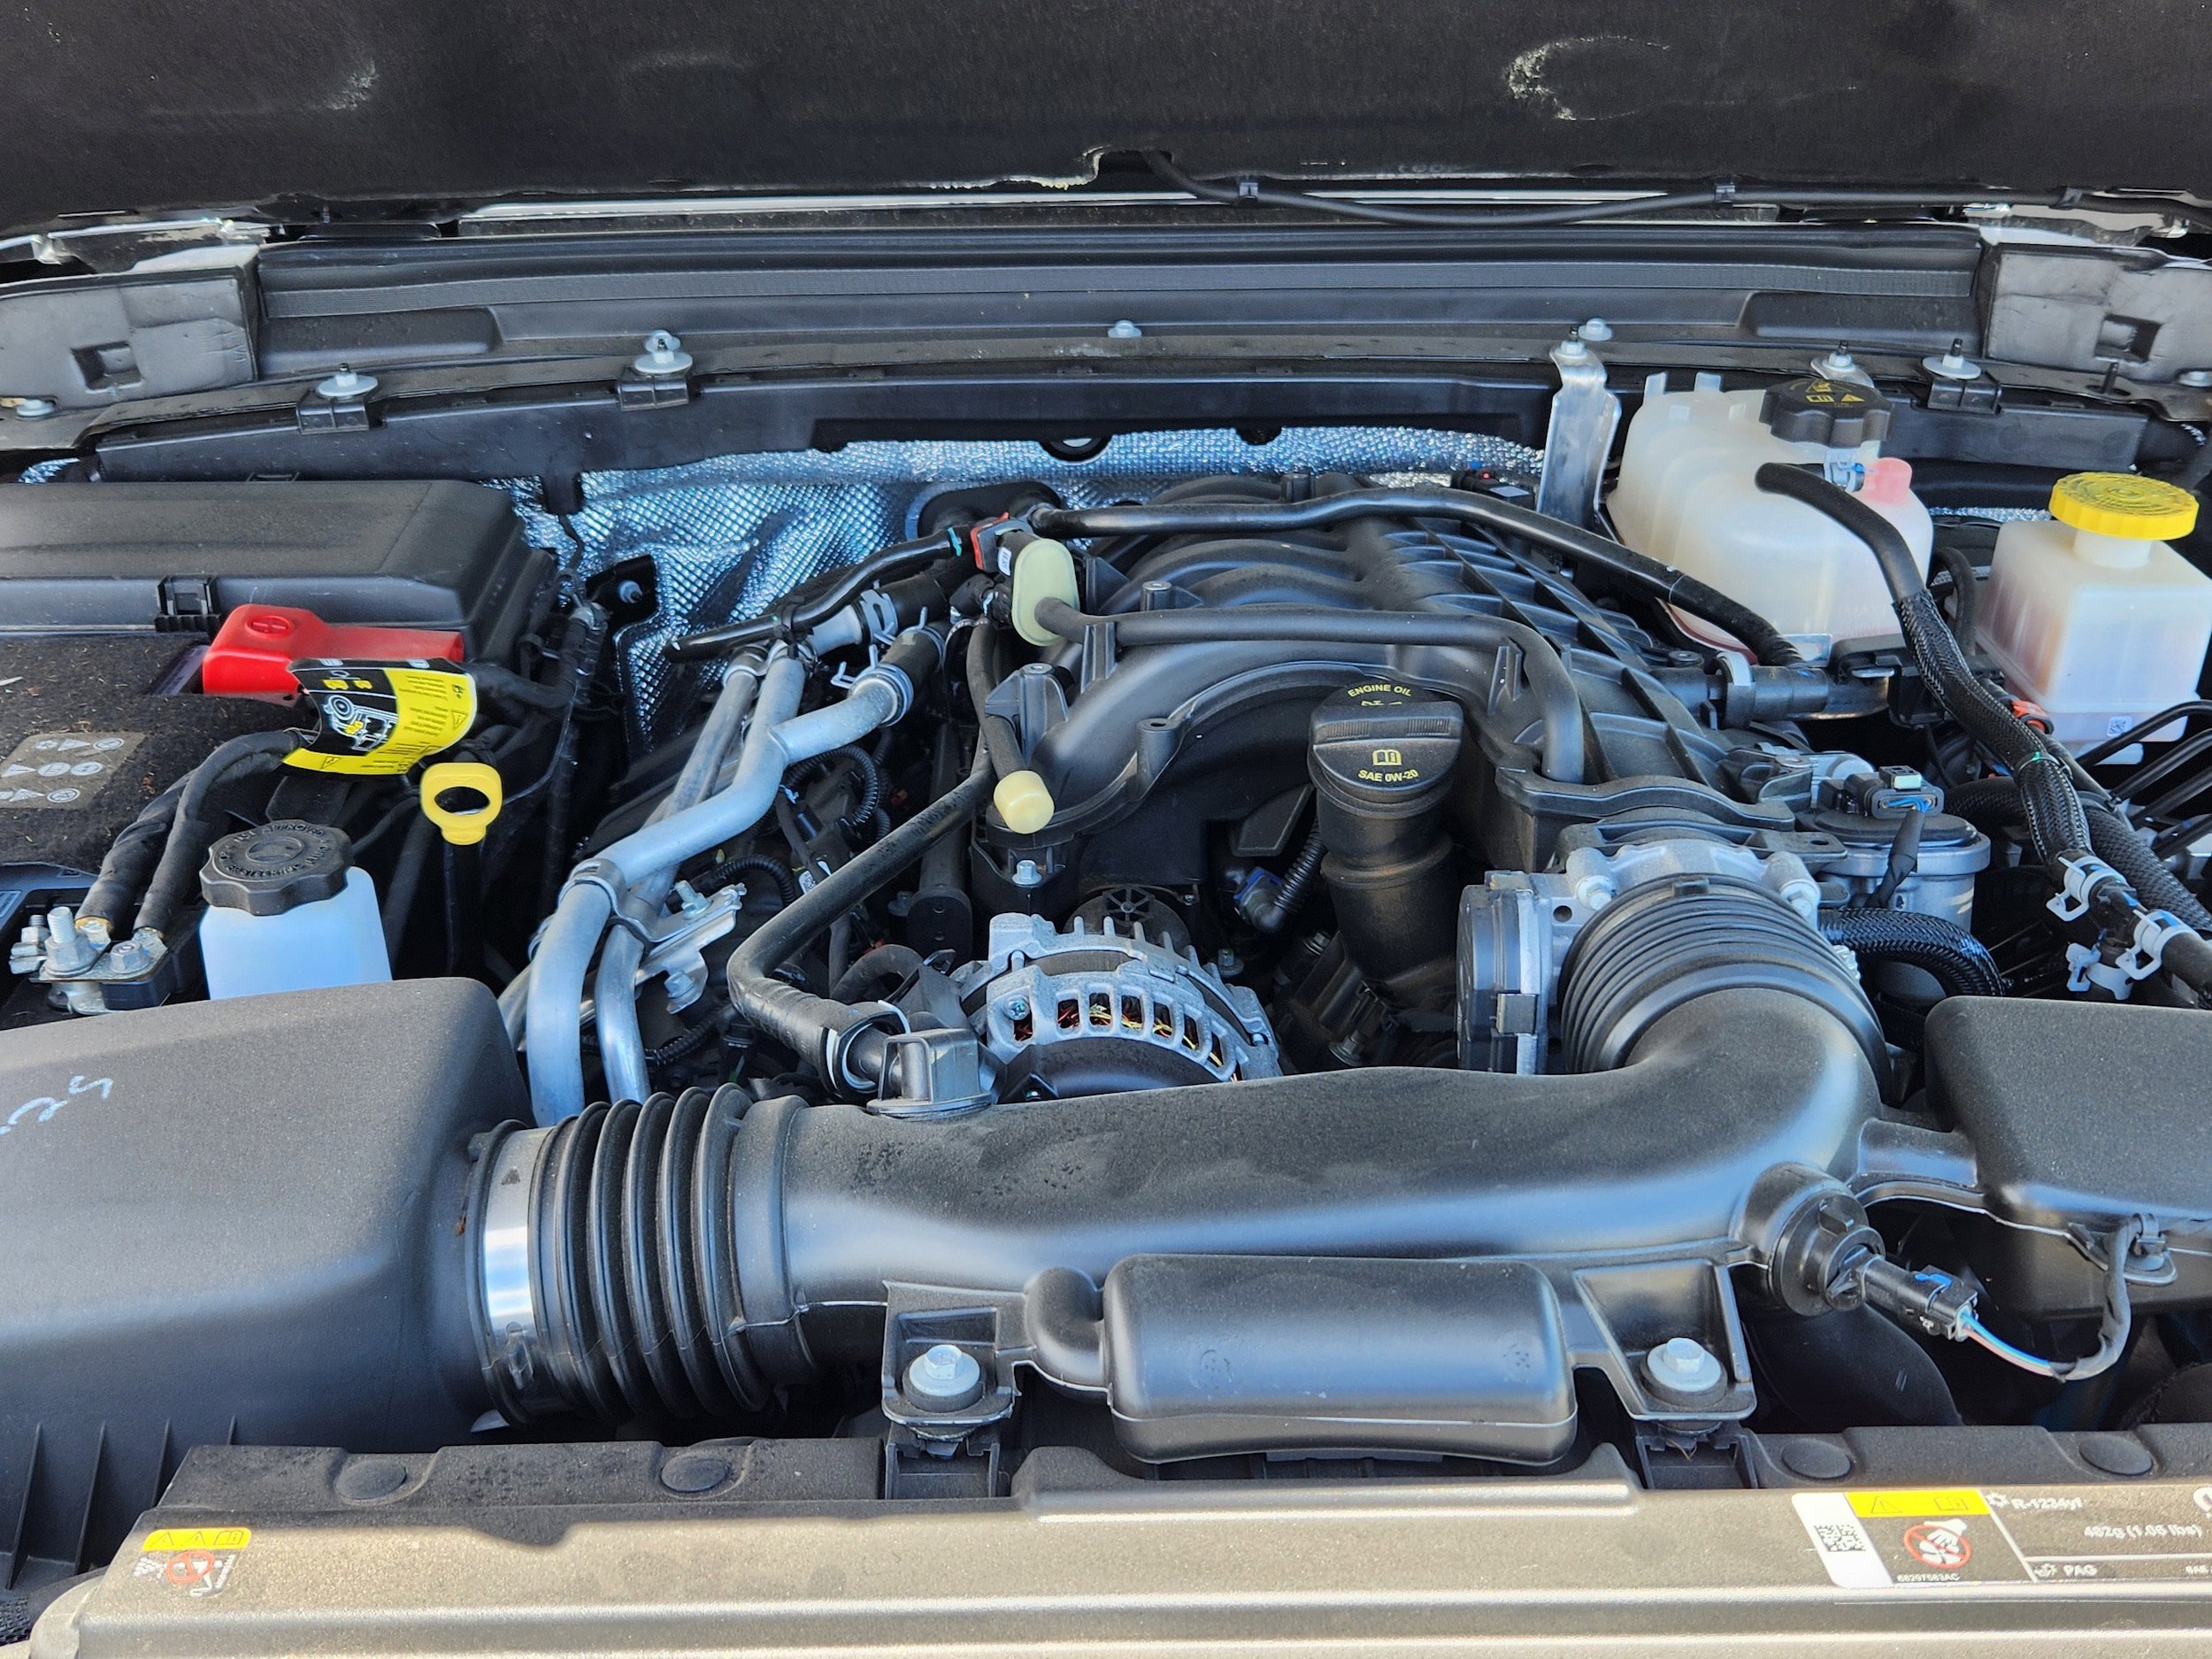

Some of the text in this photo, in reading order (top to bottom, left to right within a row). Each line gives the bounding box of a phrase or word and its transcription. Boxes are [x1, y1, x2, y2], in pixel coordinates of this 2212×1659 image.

[1347, 684, 1413, 697] ENGINE OIL
[1357, 769, 1418, 782] SAE 0W-20
[2062, 1564, 2098, 1577] PAG
